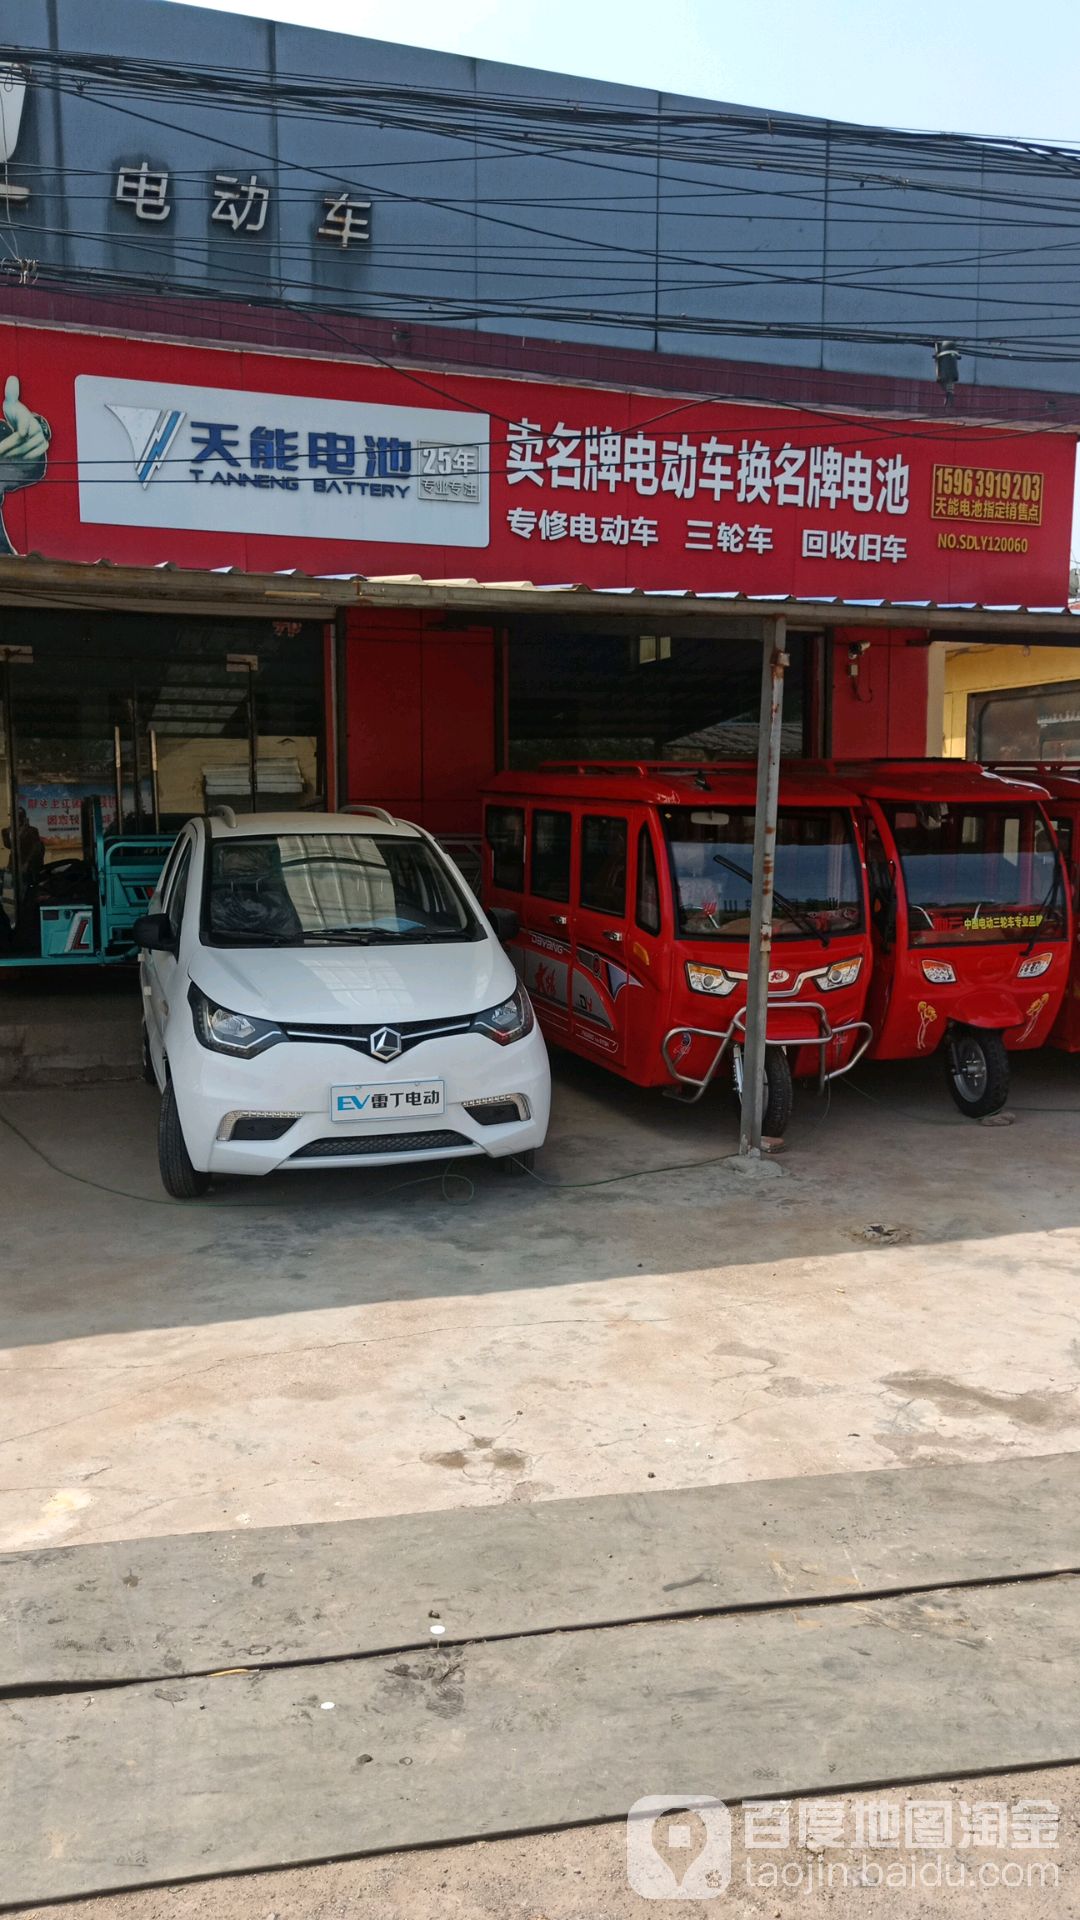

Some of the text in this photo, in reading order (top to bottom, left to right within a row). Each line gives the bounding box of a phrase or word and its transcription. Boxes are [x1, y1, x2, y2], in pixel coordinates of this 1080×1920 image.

[116, 161, 372, 248] 电动车
[190, 420, 412, 479] 天能电池
[423, 447, 476, 476] 25年
[506, 417, 910, 515] 卖名牌电动车换名牌电池
[189, 468, 411, 499] TANNENG BATTERY
[421, 479, 477, 497] 专业专注
[935, 496, 1039, 522] 天能电池指定销售点
[506, 507, 908, 563] 专修电动车 三轮车 回收旧车
[937, 533, 1028, 553] NO.SDLY120060
